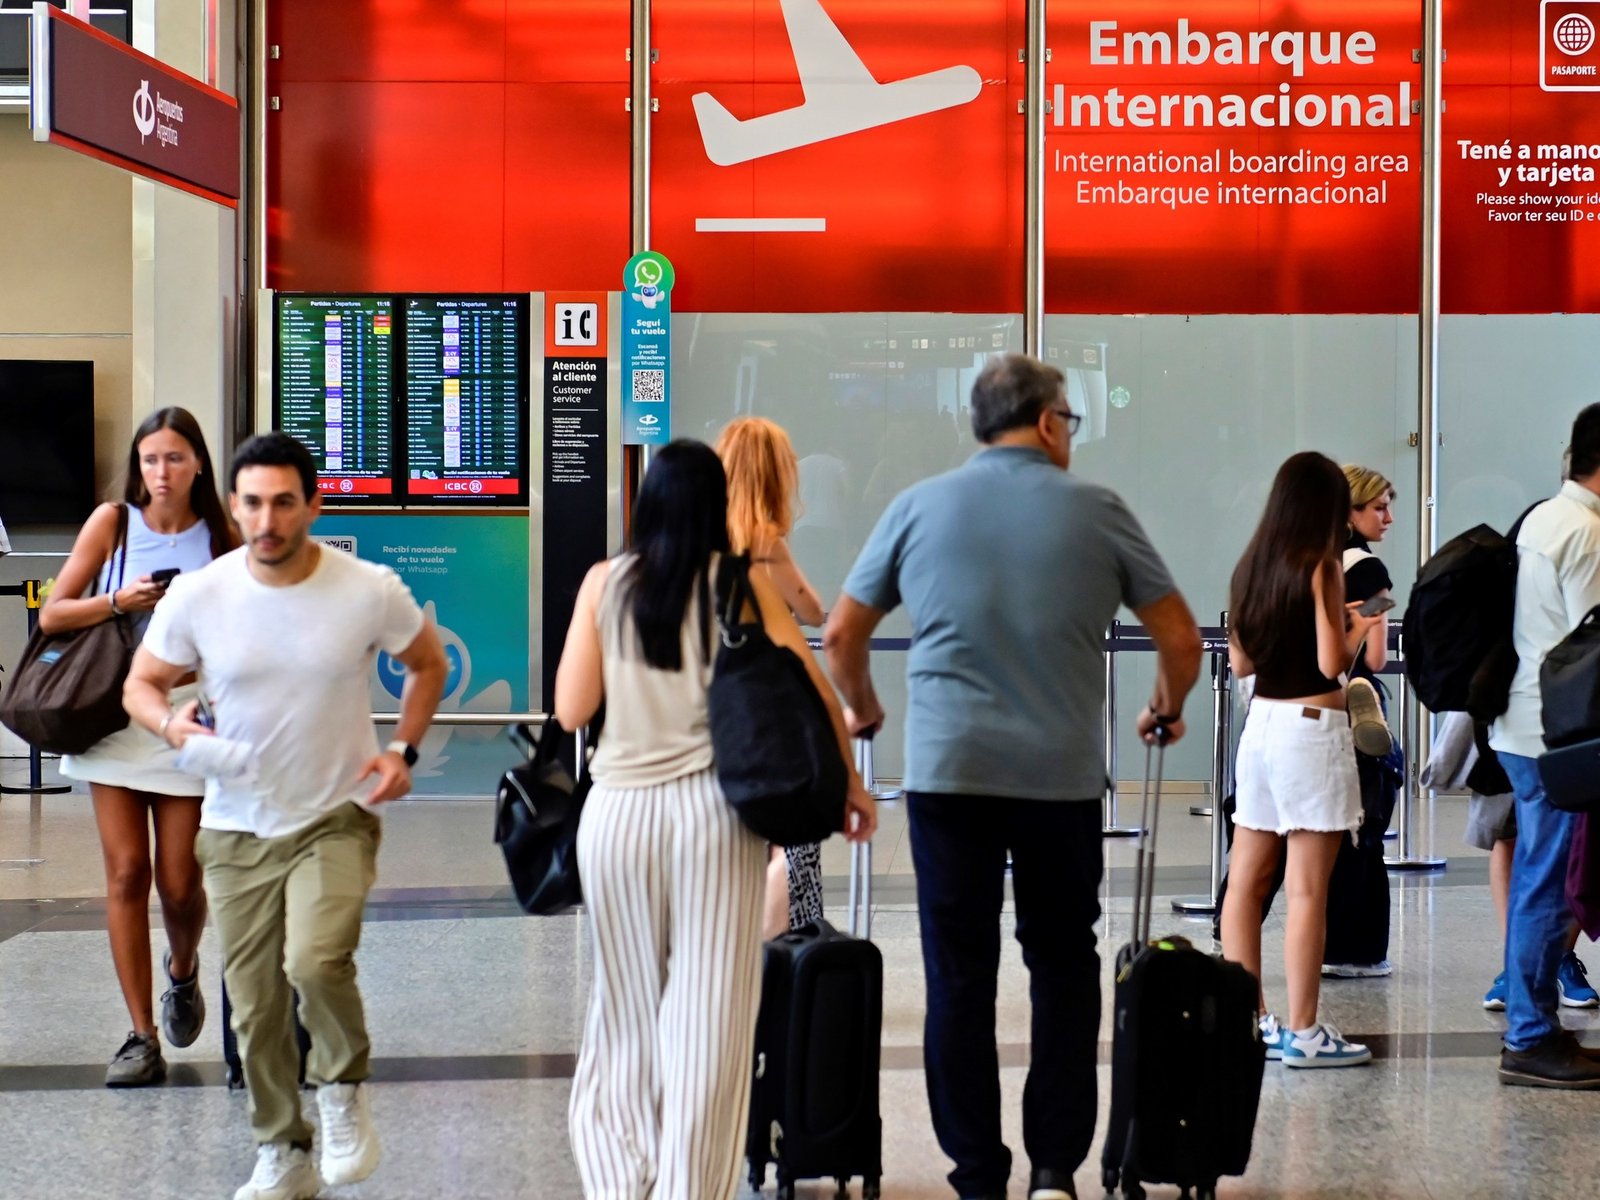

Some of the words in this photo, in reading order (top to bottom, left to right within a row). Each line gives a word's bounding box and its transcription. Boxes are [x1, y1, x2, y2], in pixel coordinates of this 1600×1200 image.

[1090, 18, 1376, 77] Embarque
[1551, 65, 1597, 76] PASAPORTE
[1053, 81, 1411, 127] Internacional
[1457, 139, 1513, 160] Tené
[1517, 144, 1532, 160] a
[1537, 144, 1600, 160] mano
[1054, 149, 1221, 173] International
[1229, 149, 1346, 179] boarding
[1354, 154, 1409, 173] area
[1498, 166, 1512, 188] y
[1516, 162, 1596, 188] tarjeta
[1076, 180, 1210, 209] Embarque
[1217, 180, 1388, 205] internacional
[1476, 193, 1516, 205] Please
[1519, 193, 1552, 205] show
[1554, 195, 1584, 207] your
[1586, 192, 1600, 205] id
[1488, 210, 1522, 221] Favor
[1525, 211, 1543, 221] ter
[1545, 212, 1567, 221] seu
[1570, 210, 1584, 221] ID
[1586, 213, 1595, 221] e
[630, 327, 640, 335] tu
[641, 327, 666, 335] vuelo
[552, 361, 597, 371] Atención
[552, 372, 562, 382] al
[563, 372, 597, 382] cliente
[552, 386, 592, 394] Customer
[552, 395, 581, 403] service
[316, 482, 335, 490] CBC
[444, 482, 468, 491] ICBC
[382, 545, 410, 553] Recibí
[411, 545, 457, 554] novedades
[420, 556, 445, 564] vuelo
[408, 566, 448, 575] Whatsapp
